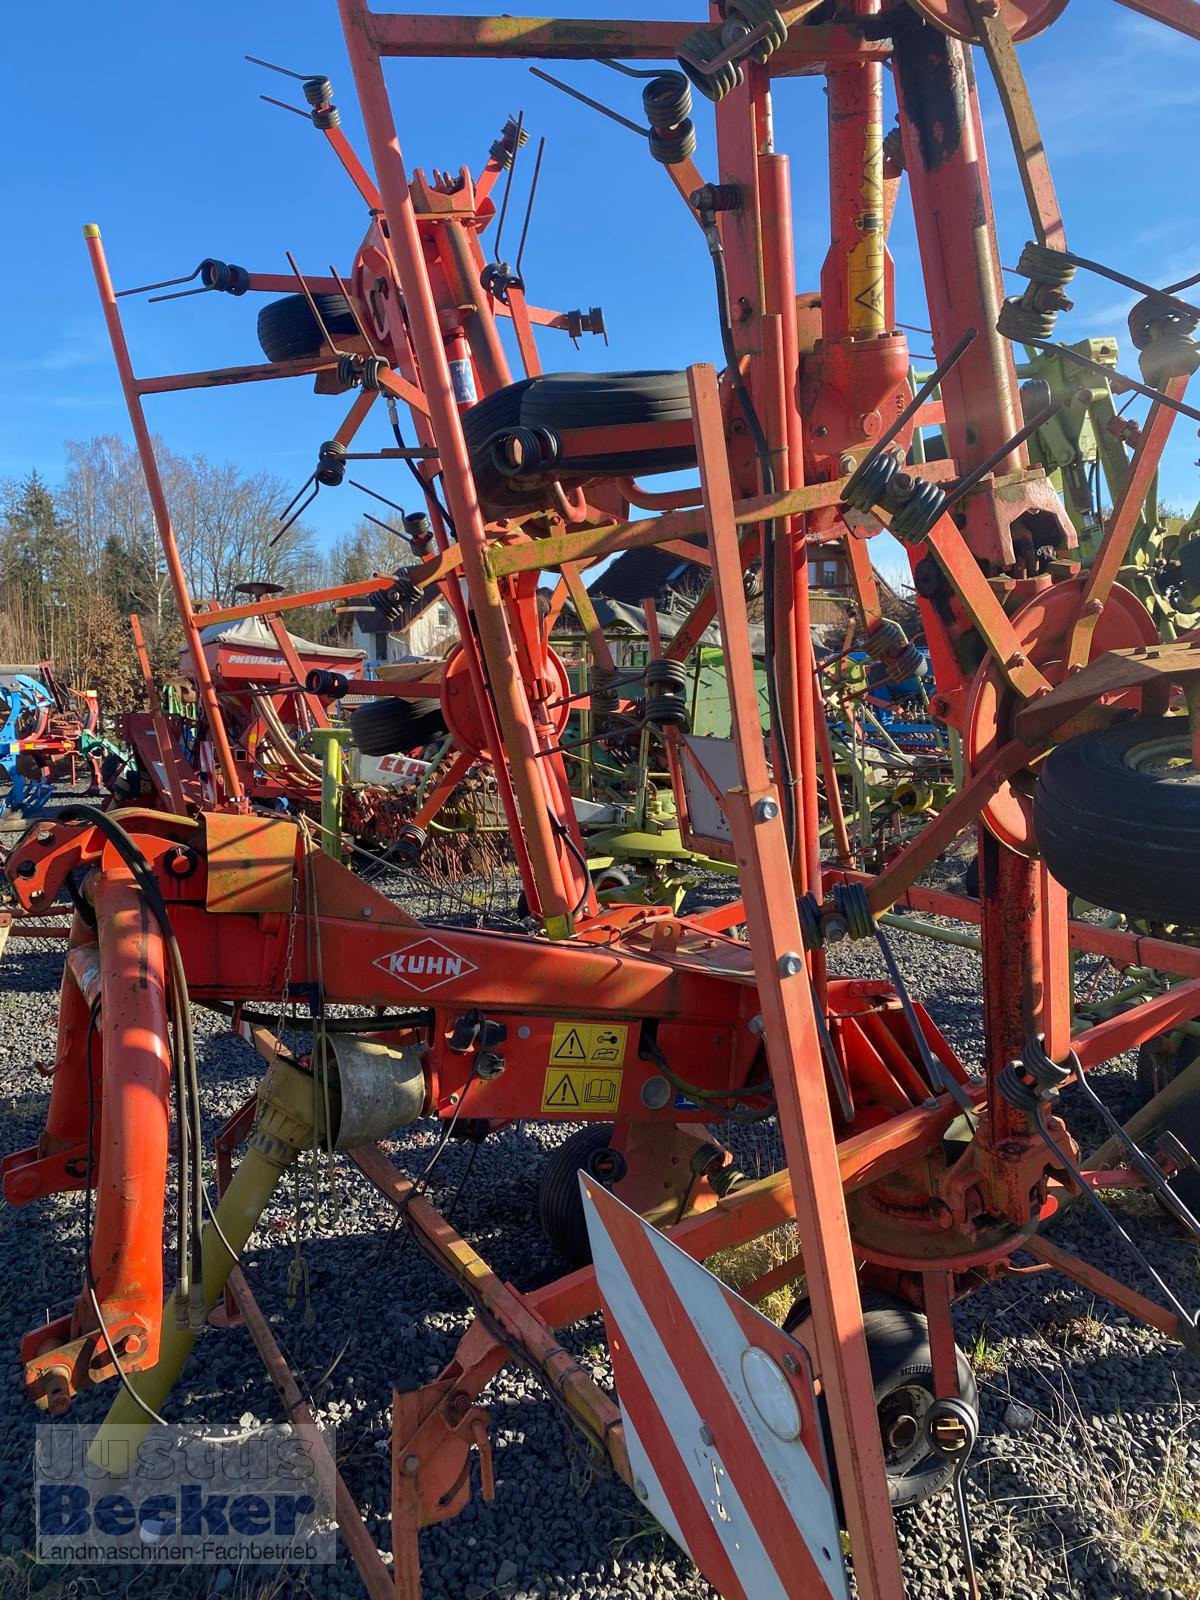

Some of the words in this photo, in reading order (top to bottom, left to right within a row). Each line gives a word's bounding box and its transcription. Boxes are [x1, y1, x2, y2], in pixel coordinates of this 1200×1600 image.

[228, 655, 287, 666] PNEUMA
[378, 756, 427, 777] CLA
[389, 954, 463, 976] KUHN
